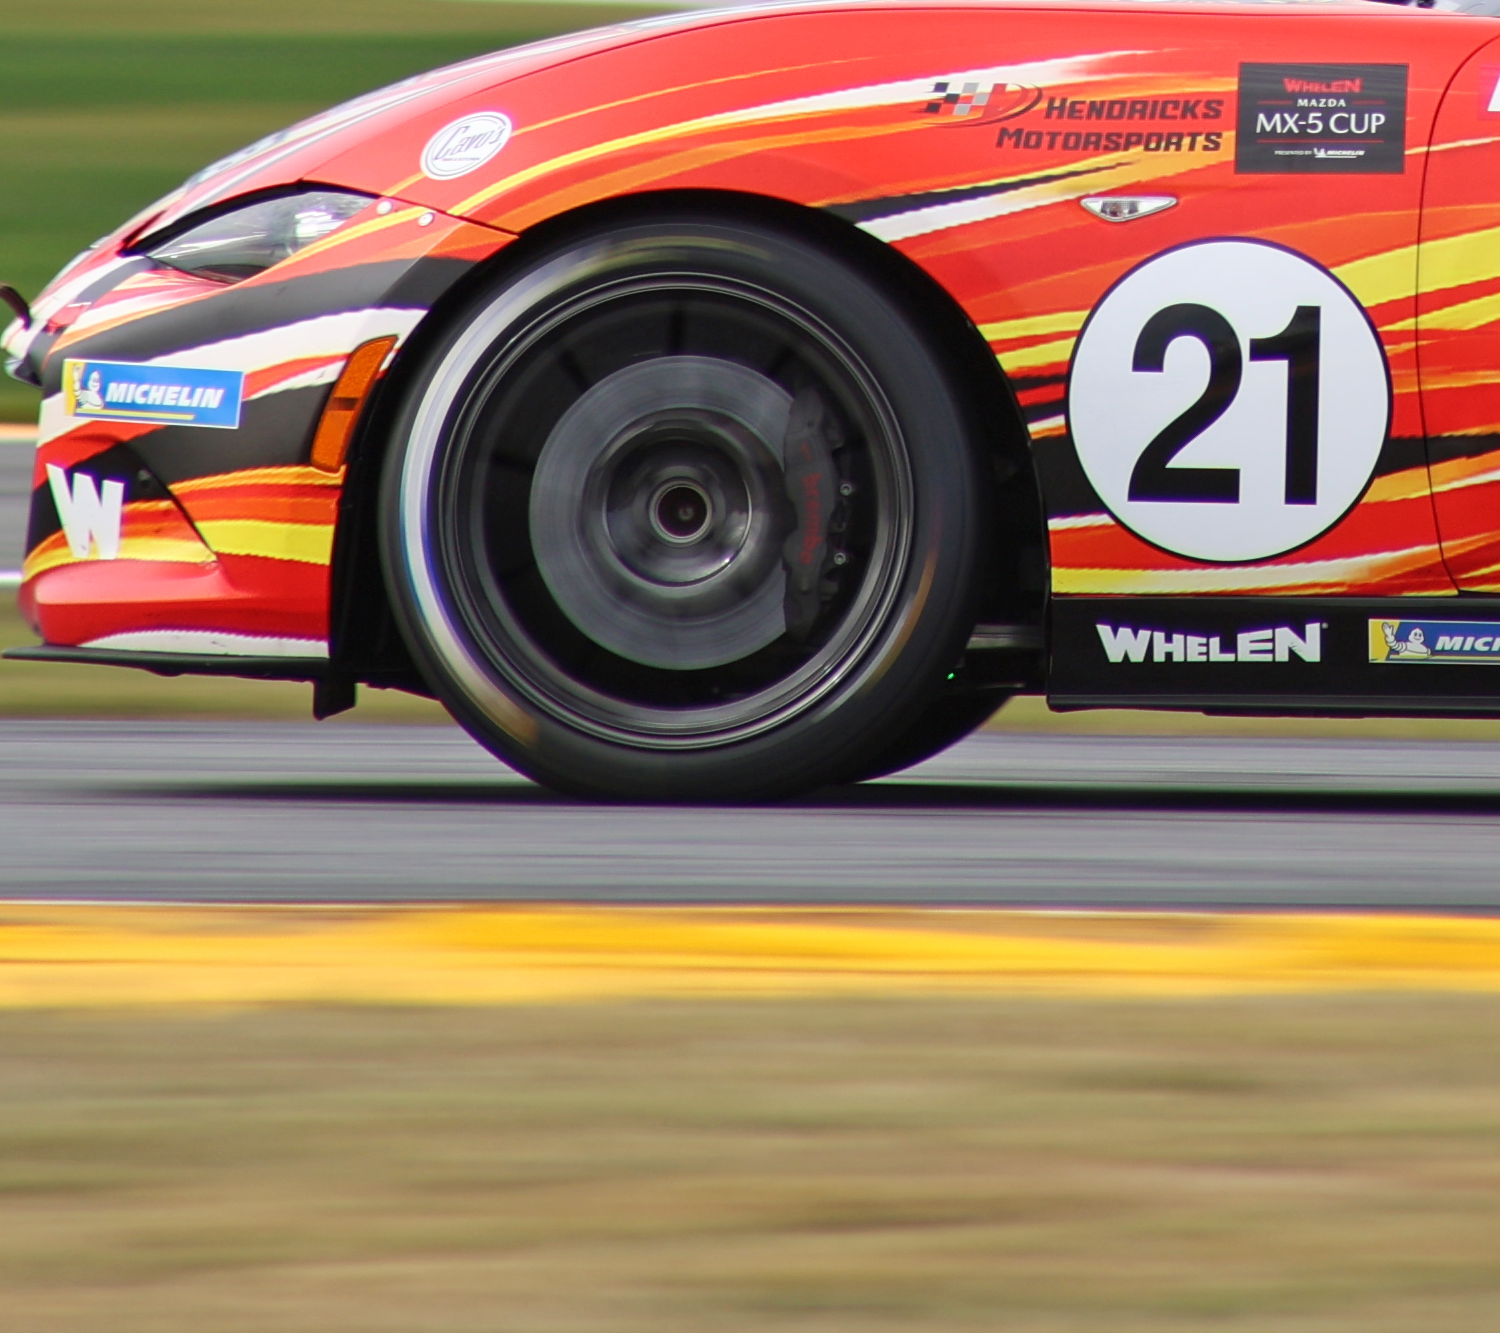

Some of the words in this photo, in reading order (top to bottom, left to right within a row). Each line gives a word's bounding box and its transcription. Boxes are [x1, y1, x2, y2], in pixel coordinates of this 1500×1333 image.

[1283, 78, 1363, 93] WHELEN
[1045, 97, 1224, 120] HENDRICKS
[1297, 99, 1346, 107] MAZDA
[1256, 113, 1323, 134] MX-5
[1329, 113, 1385, 134] CUP
[996, 127, 1223, 152] MOTORSPORTS
[106, 382, 225, 408] MICHELIN
[1128, 303, 1322, 505] 21
[46, 463, 124, 560] W
[1097, 623, 1321, 662] WHELEN
